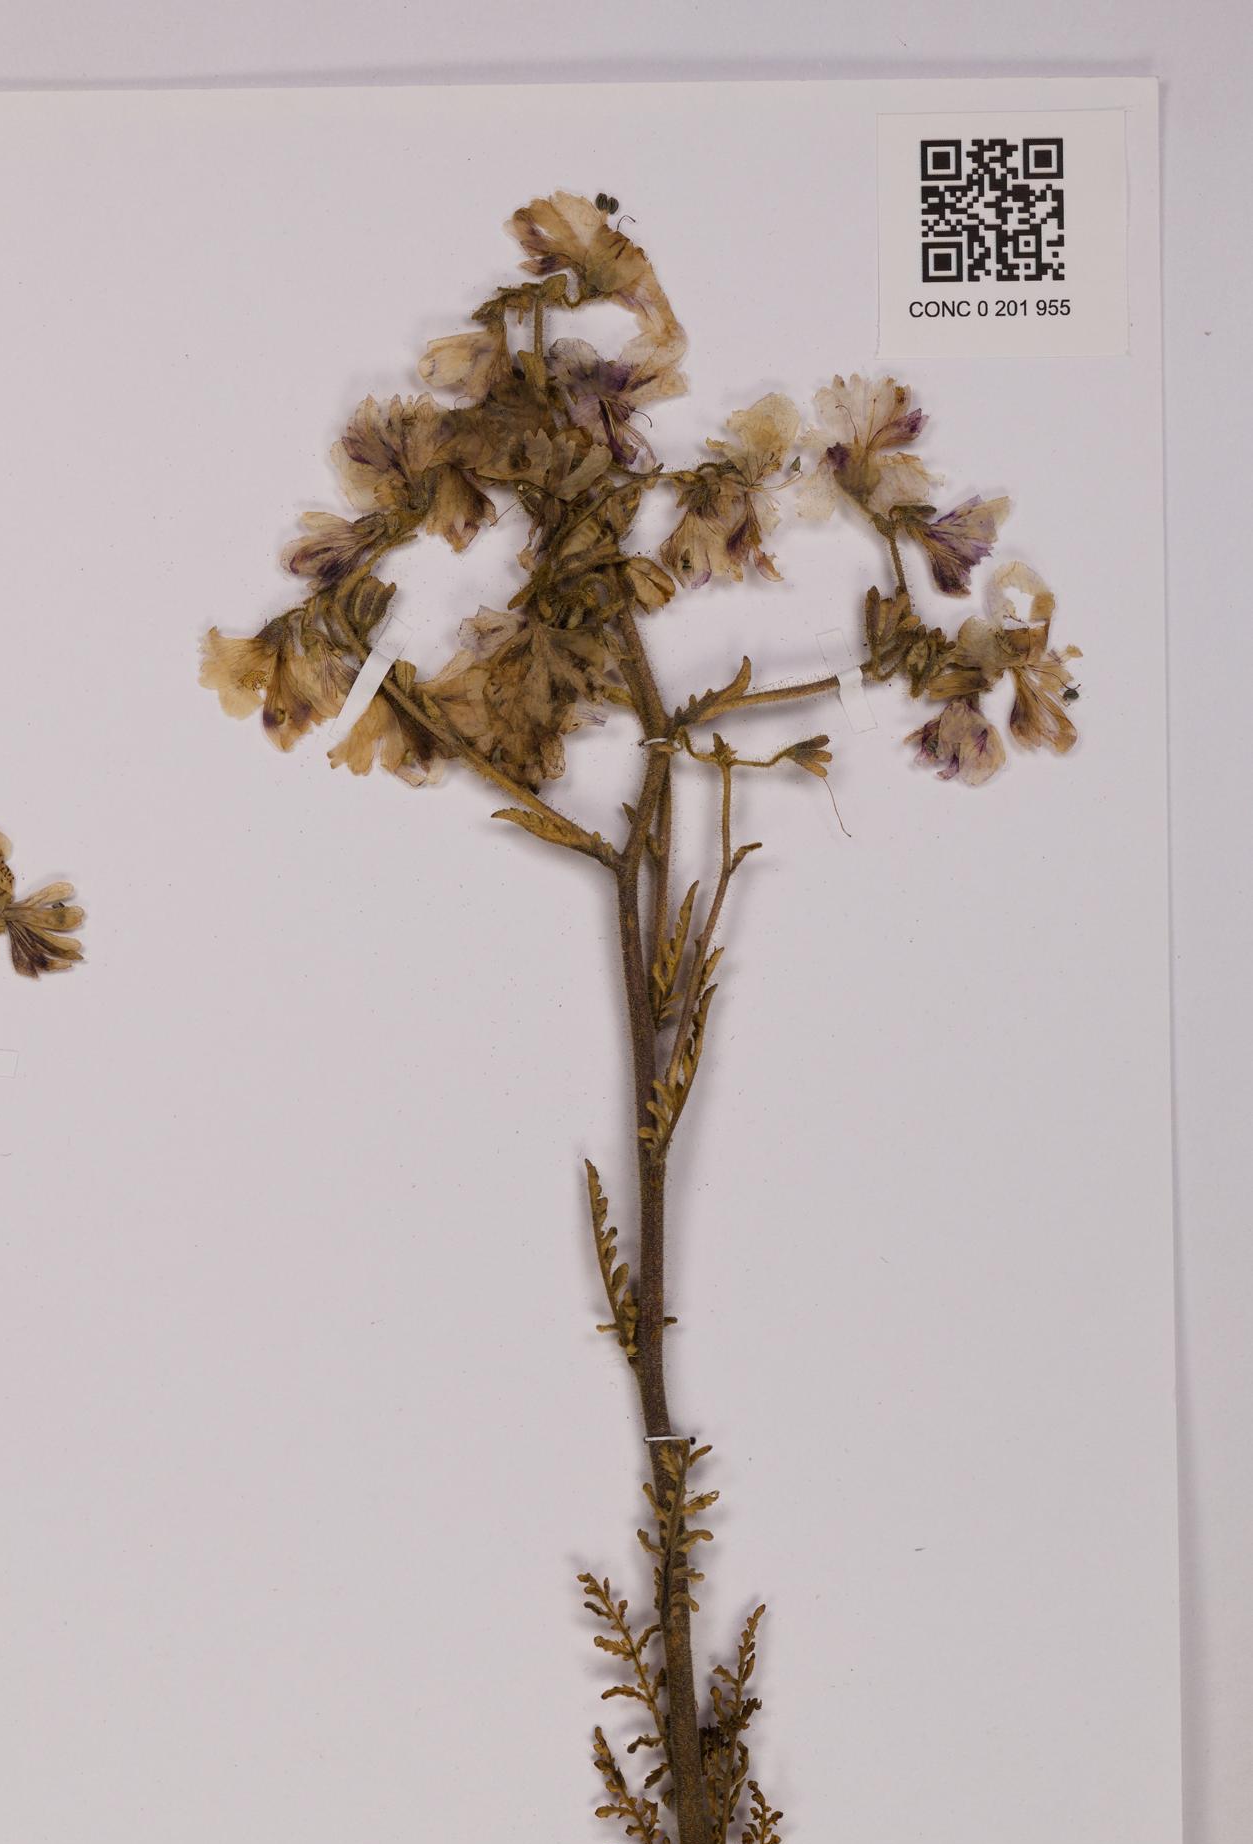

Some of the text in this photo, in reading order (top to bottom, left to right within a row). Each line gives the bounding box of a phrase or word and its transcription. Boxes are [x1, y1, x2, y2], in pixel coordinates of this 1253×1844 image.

[910, 300, 1070, 317] CONC 0 201 955
